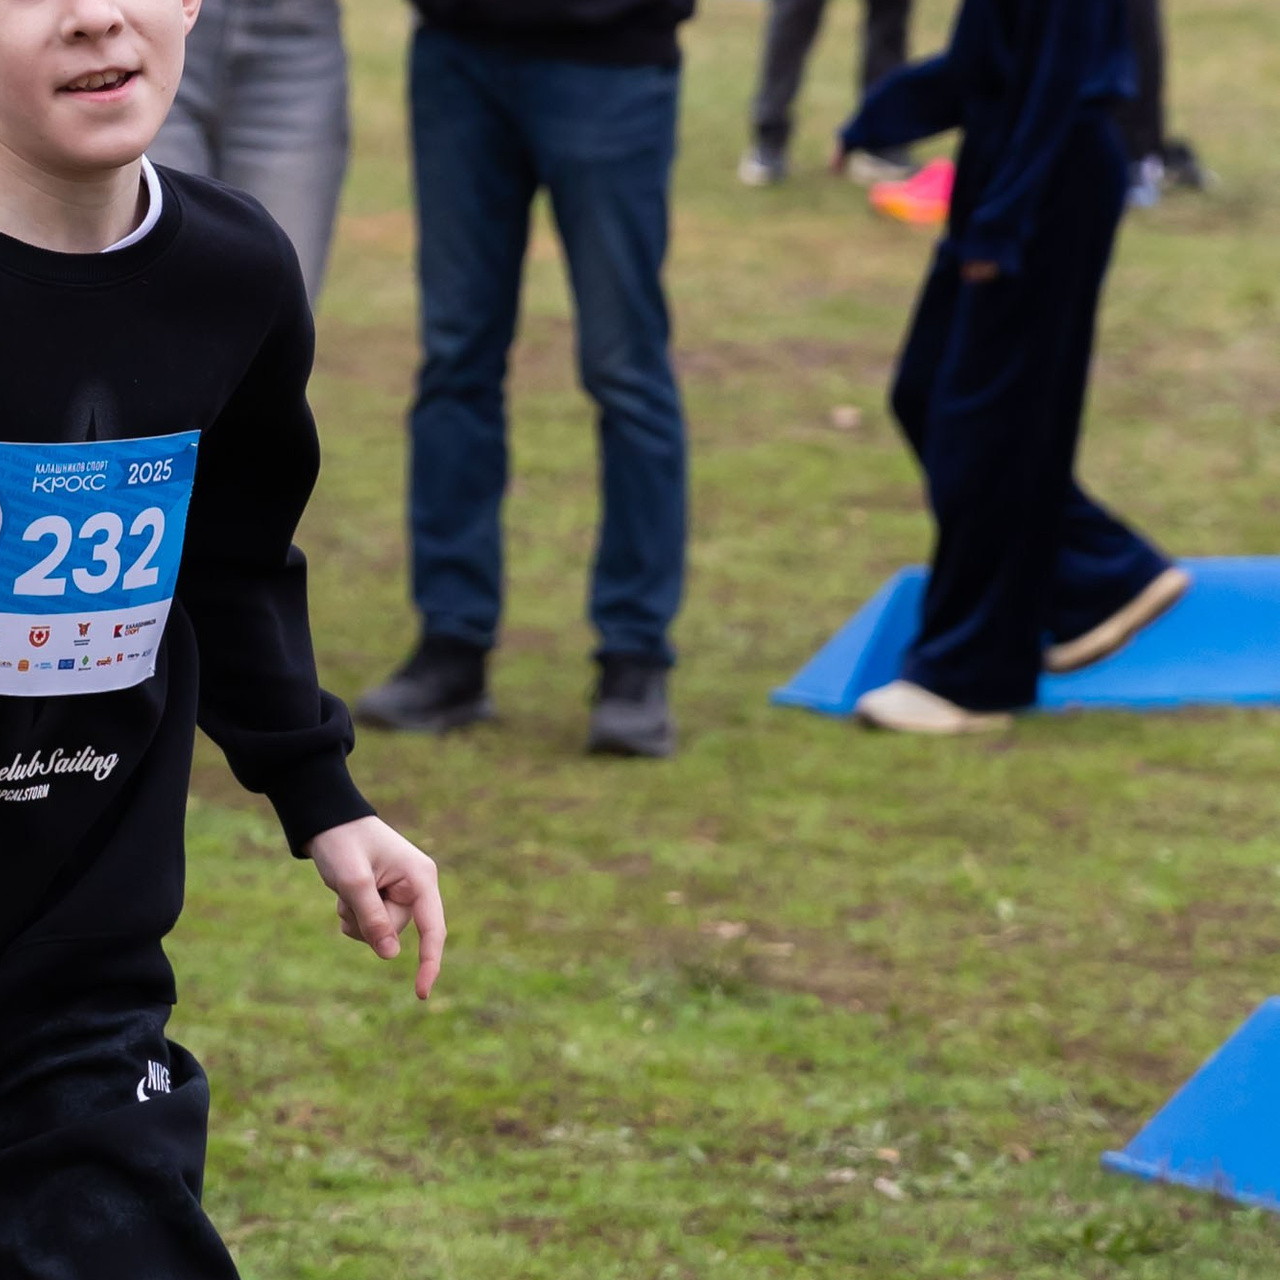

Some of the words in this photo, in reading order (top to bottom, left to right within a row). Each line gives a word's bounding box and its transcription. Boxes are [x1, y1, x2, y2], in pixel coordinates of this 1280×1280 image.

[35, 461, 85, 474] КАЛАШНИКОВ
[86, 460, 108, 472] СПОРТ
[128, 458, 173, 485] 2025
[32, 474, 106, 493] КРОСС
[13, 506, 165, 596] 232
[147, 1059, 171, 1094] NIKE
